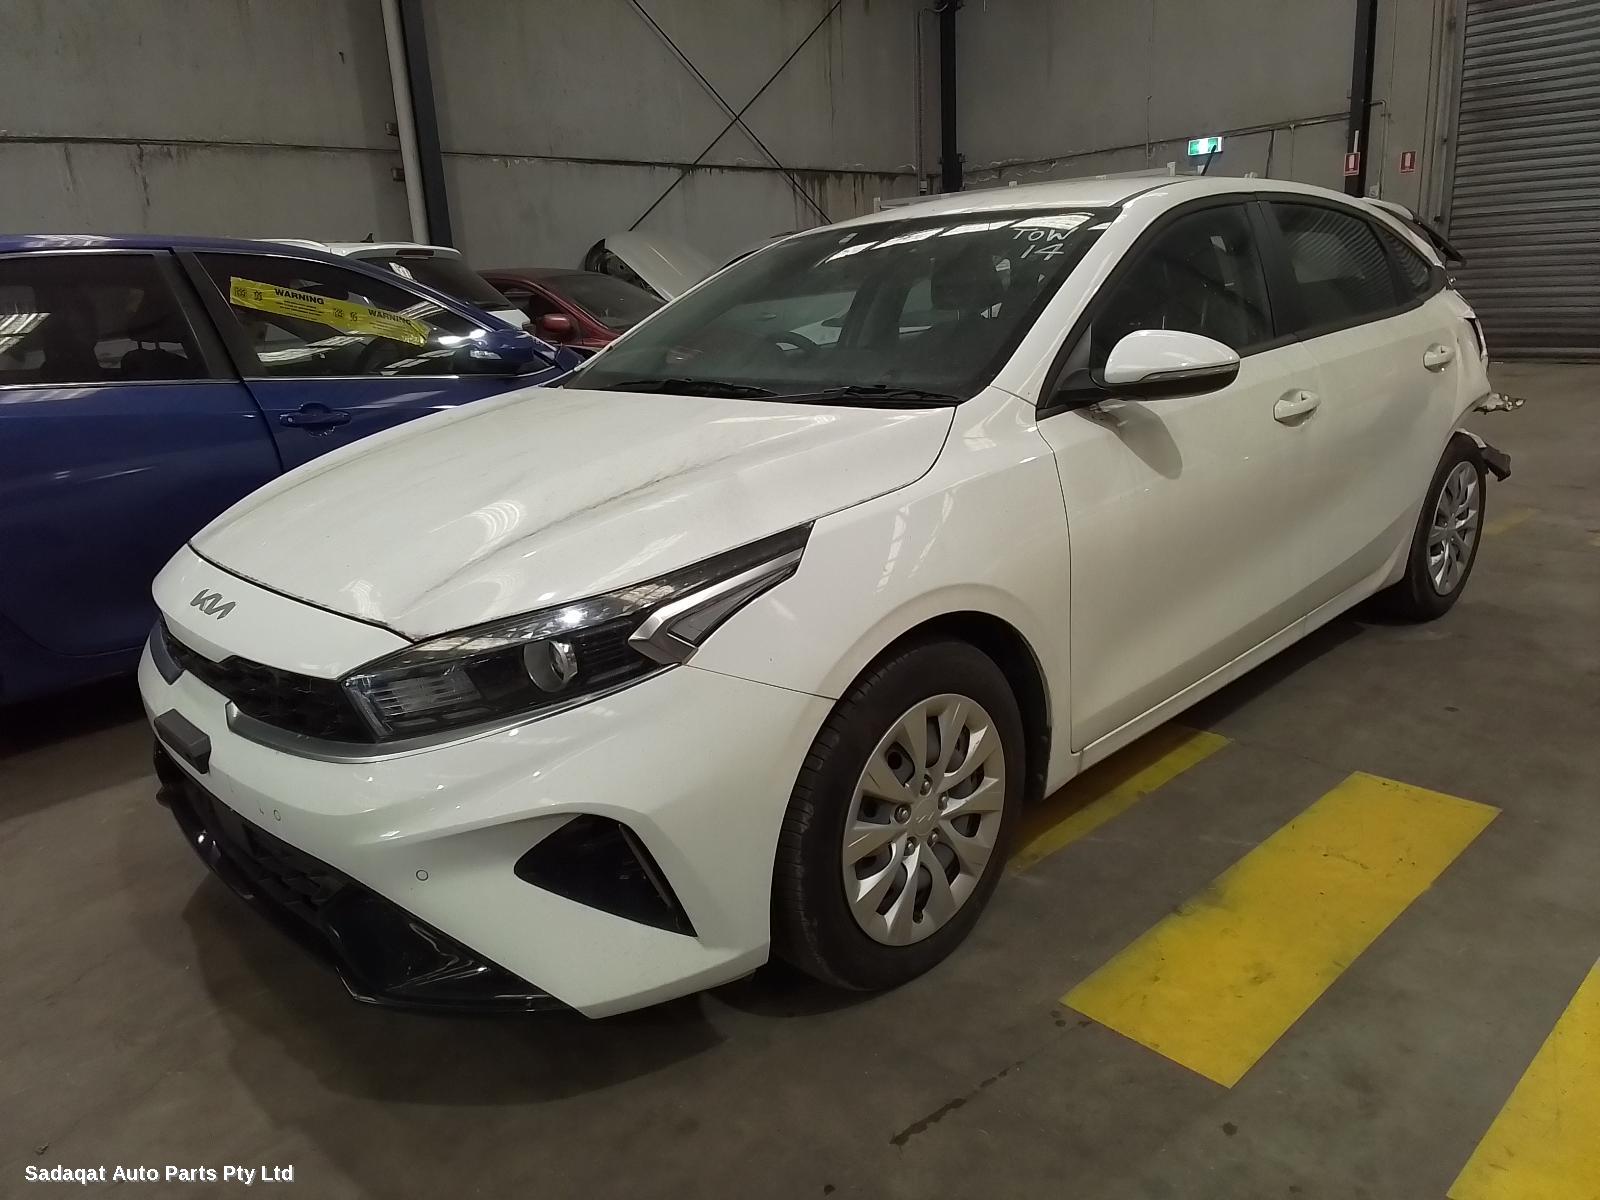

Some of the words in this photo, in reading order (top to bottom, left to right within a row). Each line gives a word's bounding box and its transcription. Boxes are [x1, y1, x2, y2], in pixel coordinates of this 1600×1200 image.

[1012, 226, 1080, 242] TOW
[1020, 242, 1065, 261] 14
[274, 288, 325, 305] WARNING
